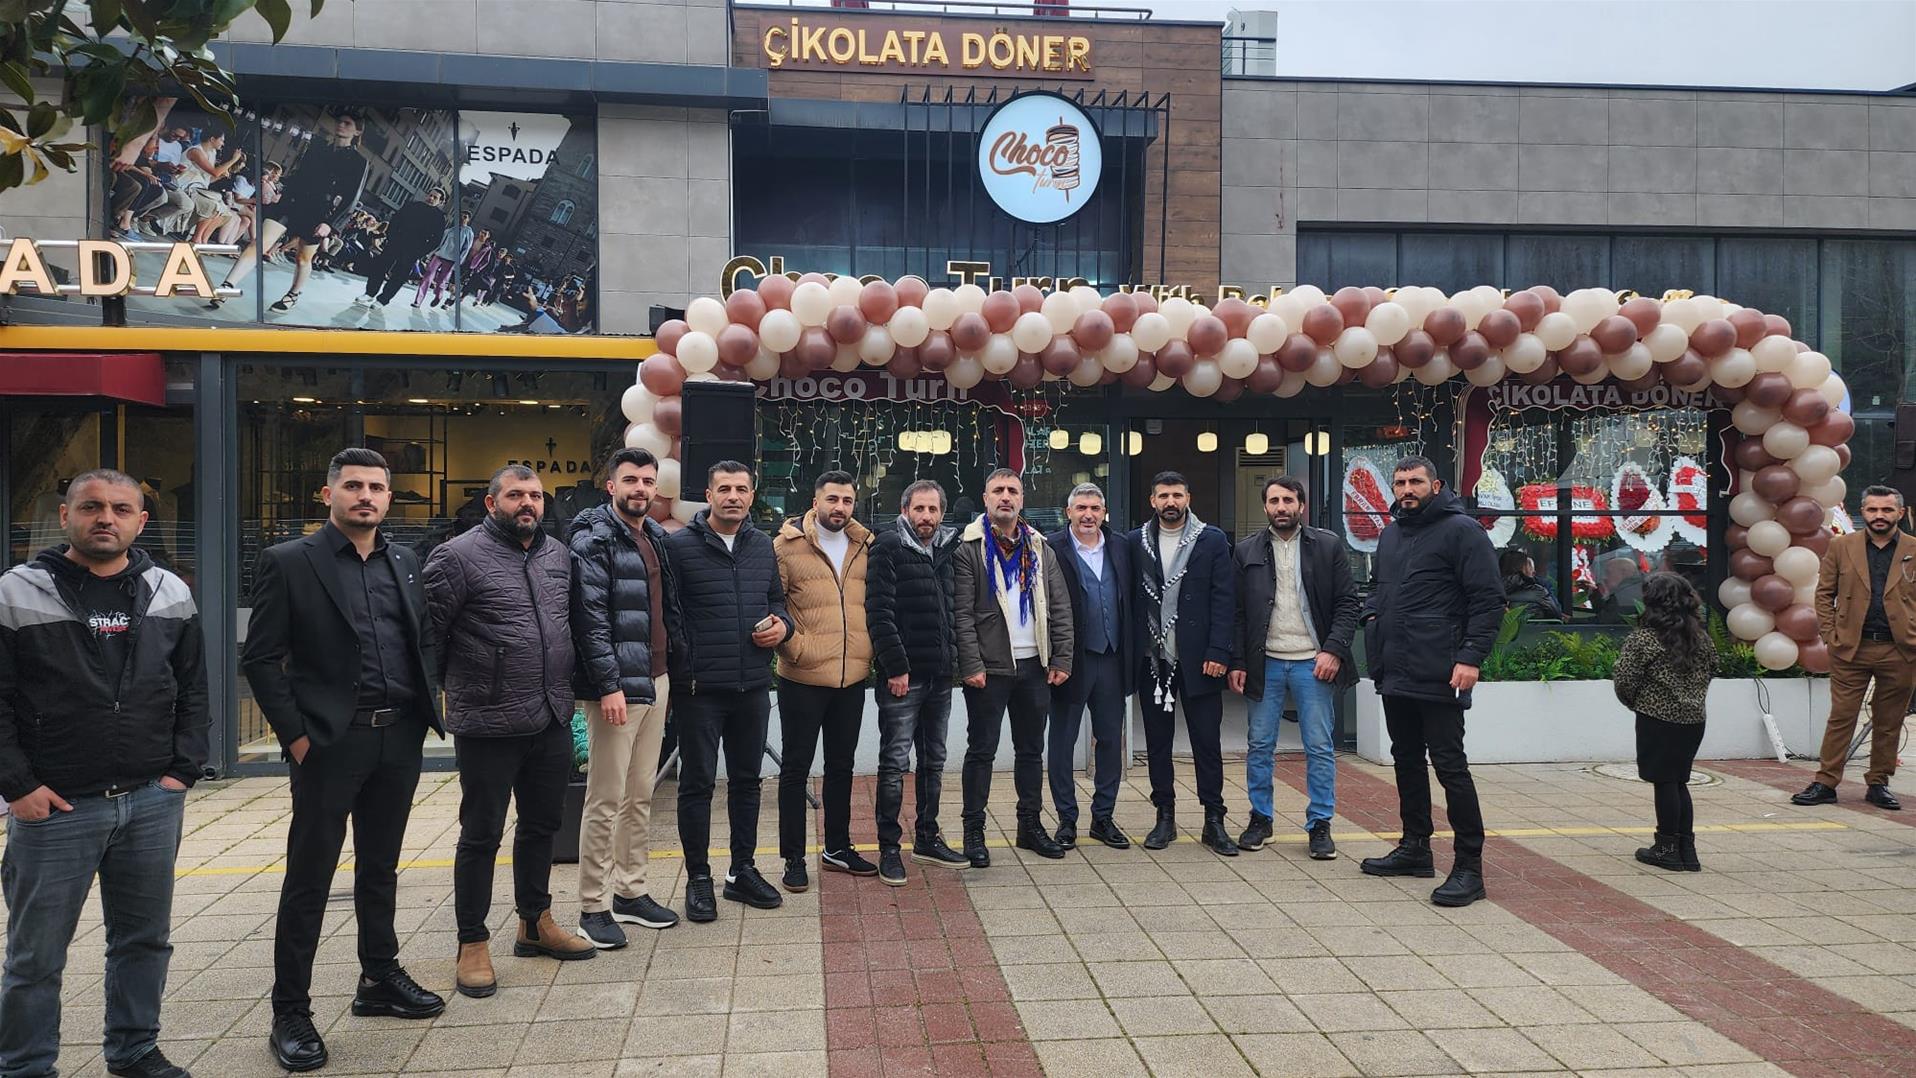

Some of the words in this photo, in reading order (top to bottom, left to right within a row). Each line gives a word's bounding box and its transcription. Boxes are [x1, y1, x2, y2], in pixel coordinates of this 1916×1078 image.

[764, 17, 950, 69] ÇİKOLATA
[962, 27, 1092, 71] DÖNER
[467, 145, 561, 165] ESPADA
[990, 131, 1069, 176] Choco
[0, 237, 218, 298] ADA
[755, 374, 867, 399] hoco
